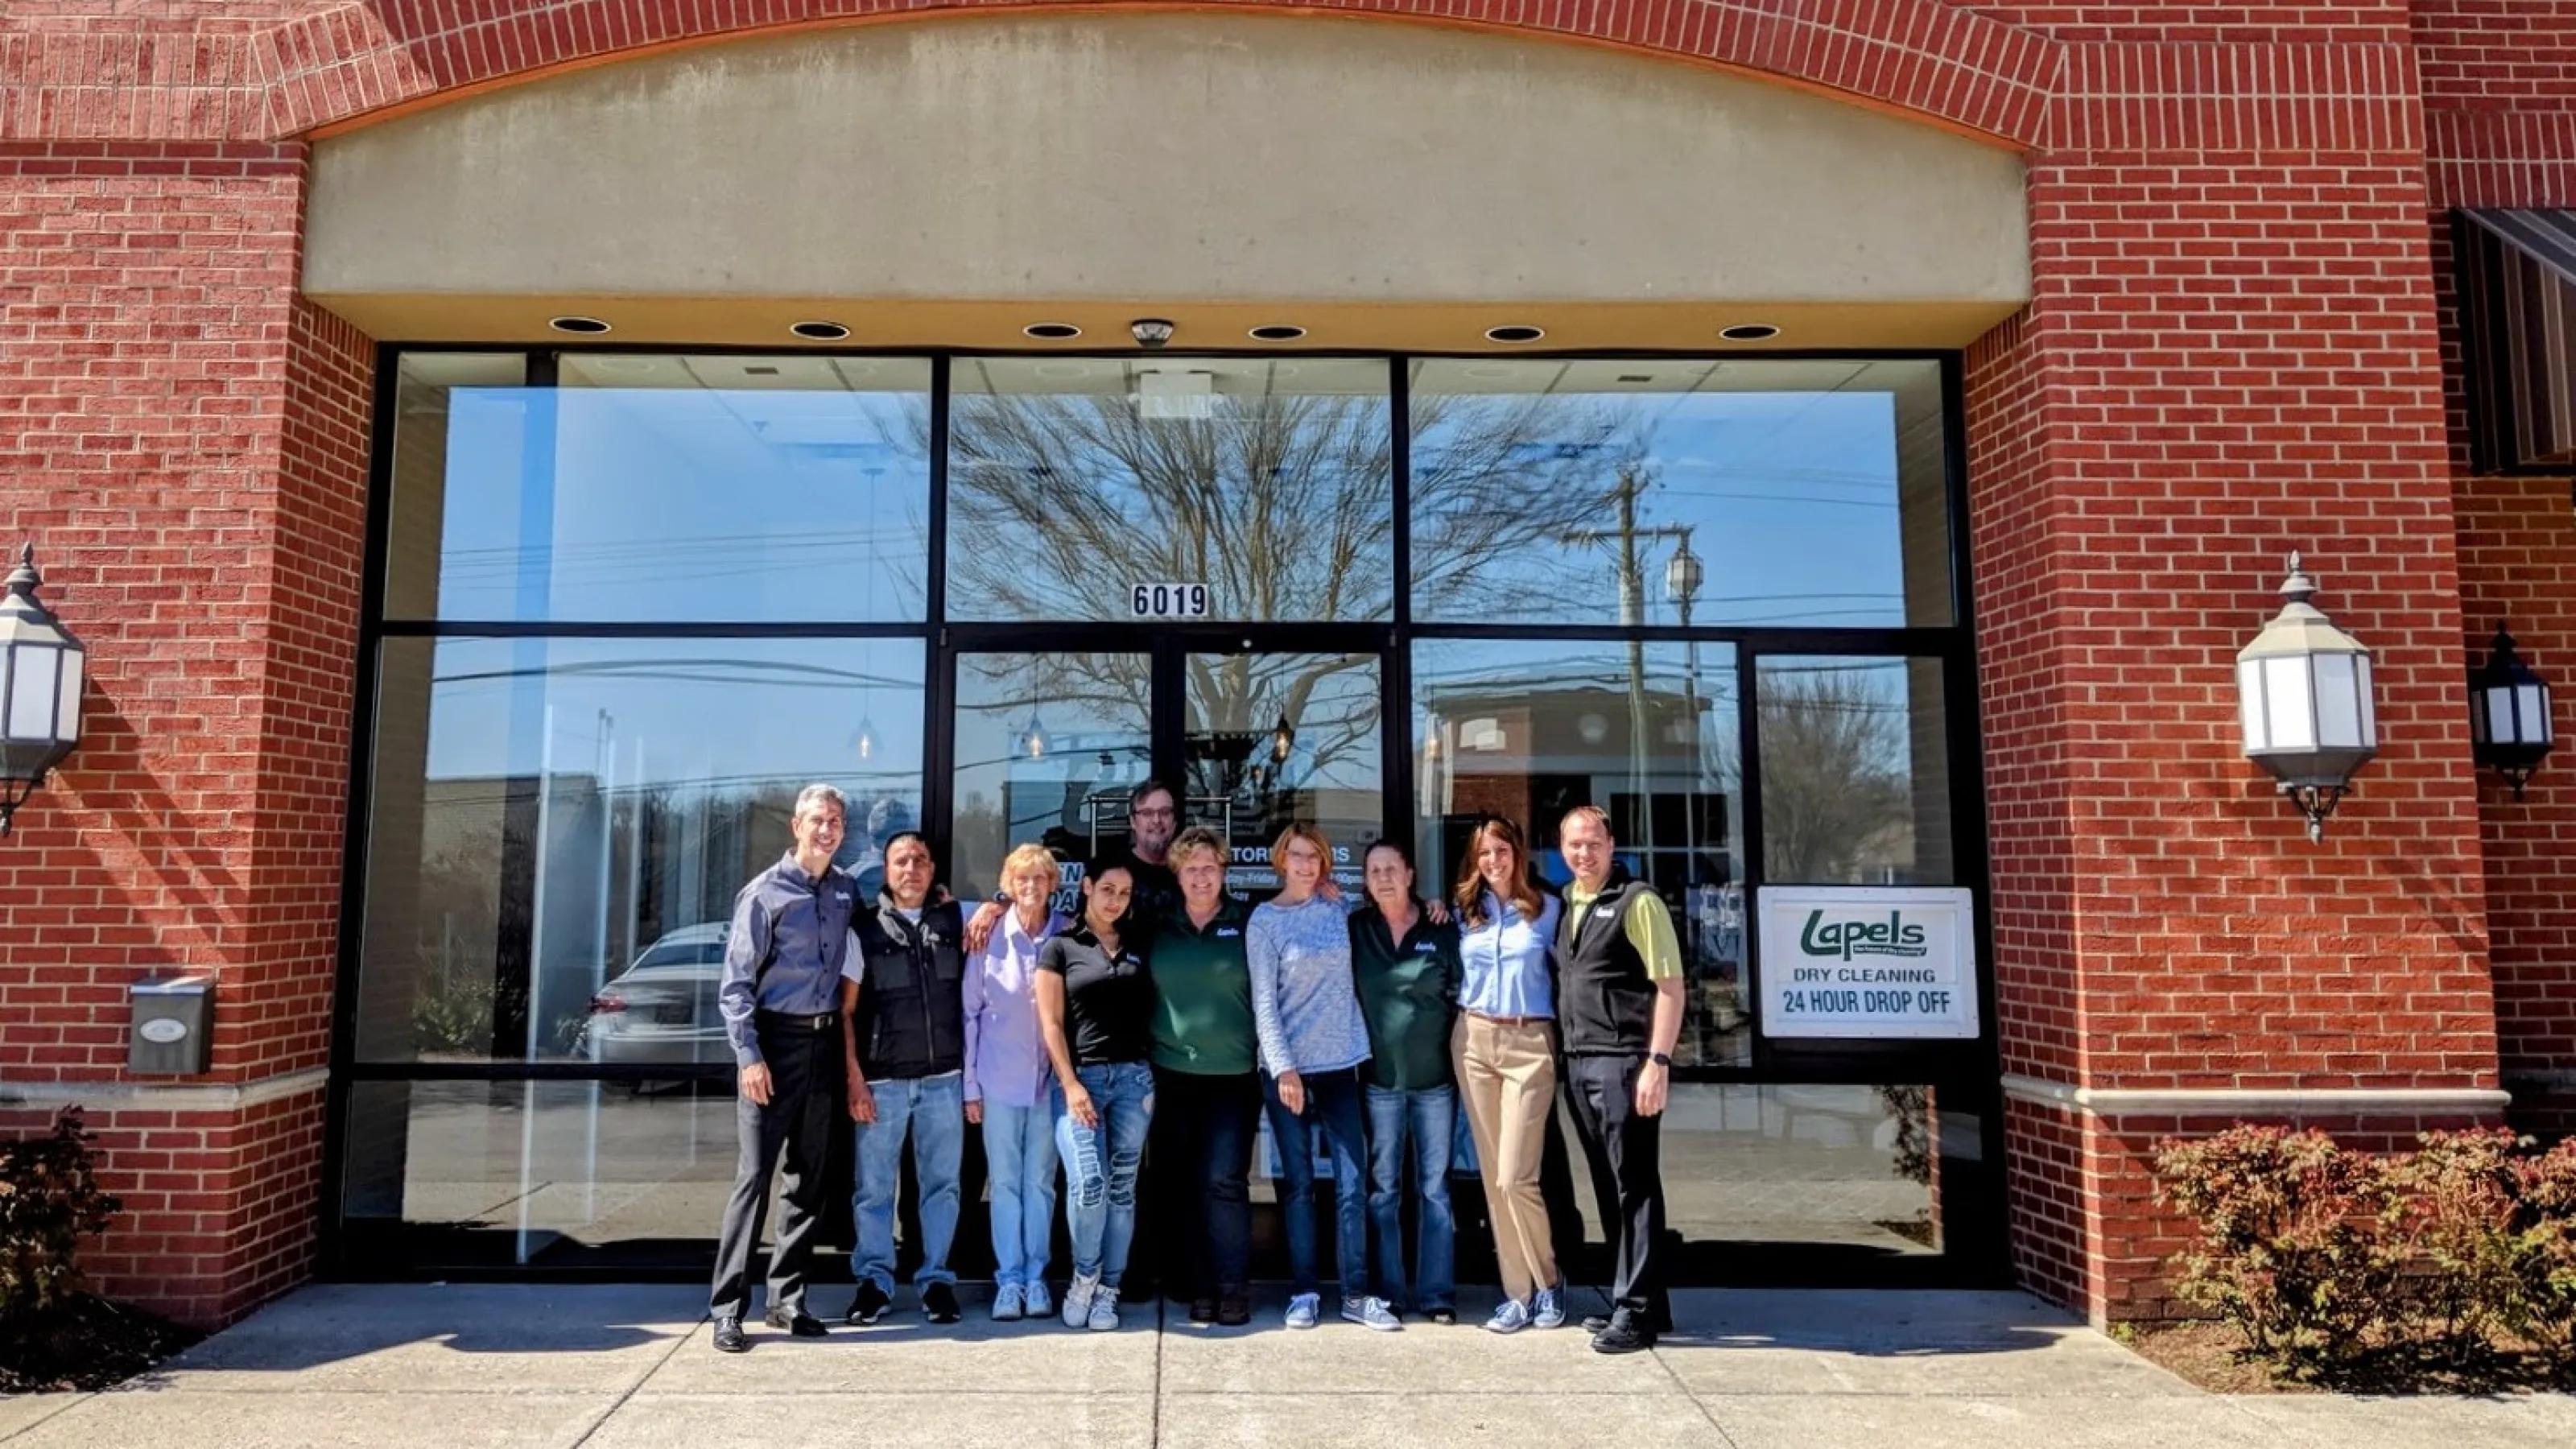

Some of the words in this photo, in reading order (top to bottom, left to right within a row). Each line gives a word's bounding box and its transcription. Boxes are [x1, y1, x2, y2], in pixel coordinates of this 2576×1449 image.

[1133, 585, 1206, 616] 6019
[1231, 846, 1275, 863] TOR
[1800, 909, 1925, 961] Lapels
[1794, 968, 1831, 983] DRY
[1838, 968, 1936, 983] CLEANING
[1783, 990, 1806, 1013] 24
[1810, 990, 1859, 1013] HOUR
[1863, 990, 1912, 1013] DROP
[1918, 990, 1951, 1013] OFF
